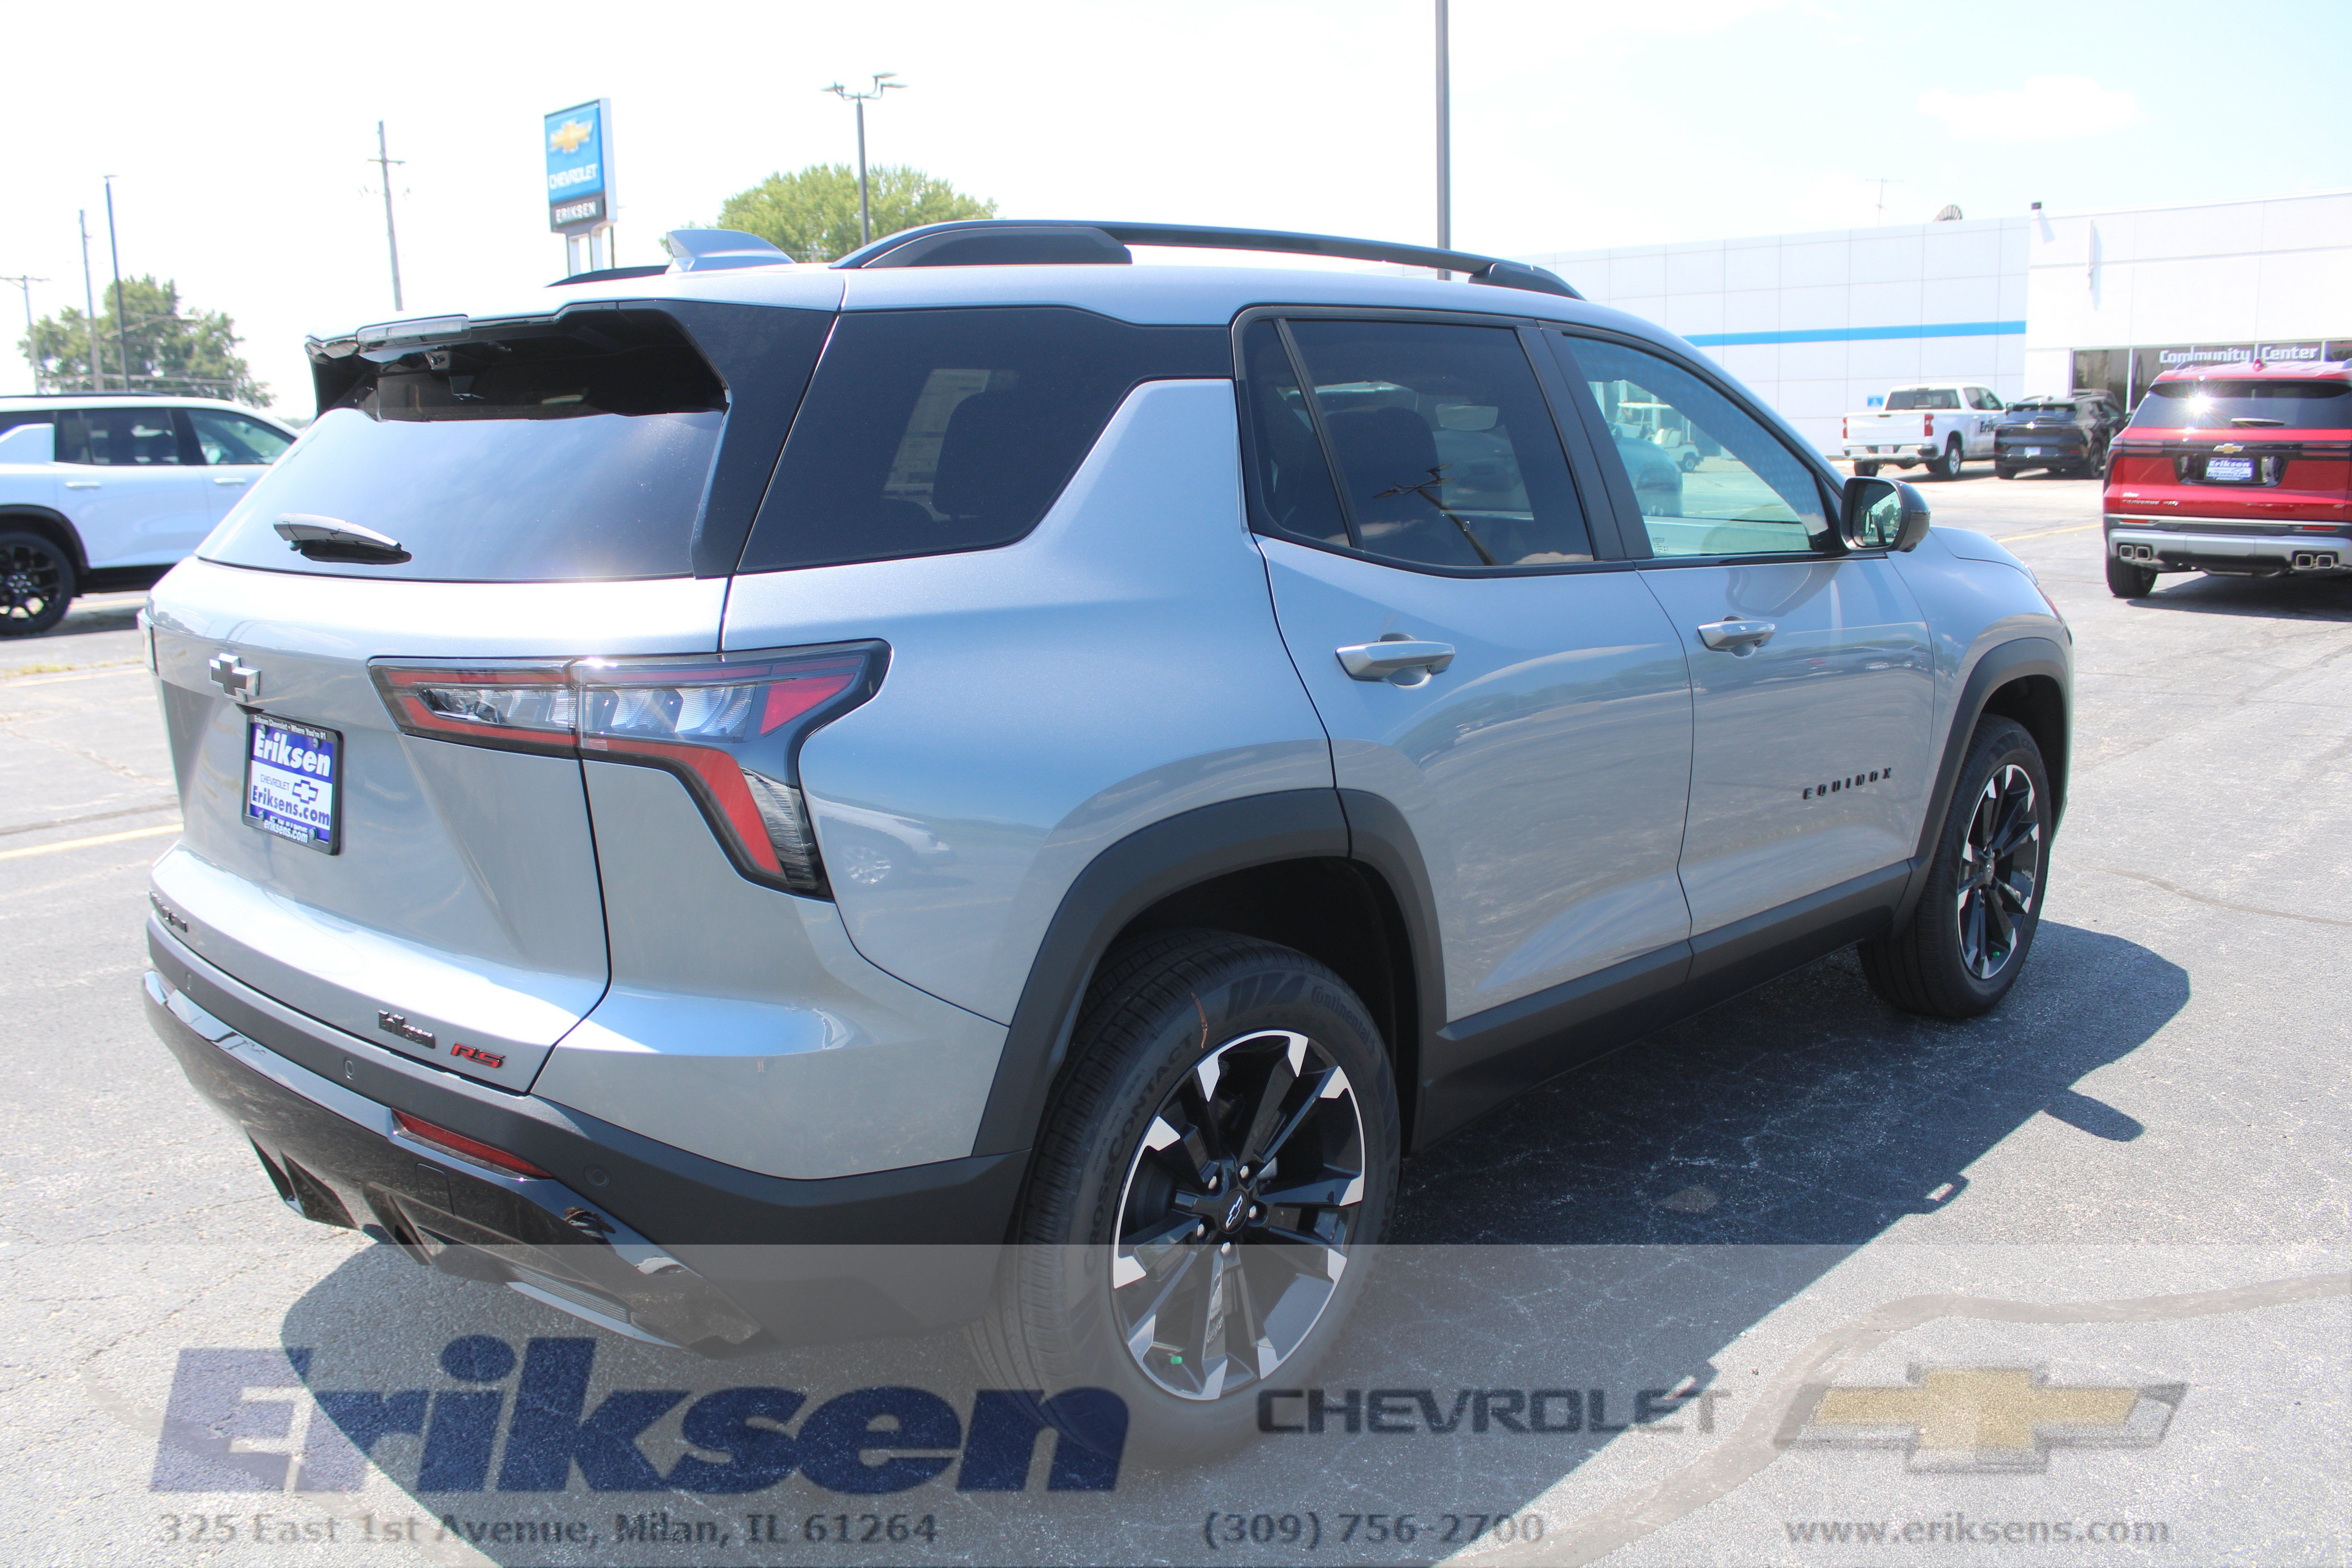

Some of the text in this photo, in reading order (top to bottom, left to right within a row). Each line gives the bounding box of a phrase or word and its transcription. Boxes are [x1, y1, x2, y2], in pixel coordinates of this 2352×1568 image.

[549, 163, 597, 189] CHEVROLET
[555, 202, 597, 223] ERIKSEN
[2159, 345, 2319, 364] Community Center
[254, 715, 269, 725] Eriksen
[269, 719, 288, 731] Chevrolet
[253, 728, 332, 777] Eriksen
[260, 774, 290, 791] CHEVROLET
[1802, 767, 1891, 800] EQUINOX
[252, 785, 331, 826] Eriksens.com
[264, 820, 309, 843] eriksens.com
[450, 1042, 506, 1069] RS
